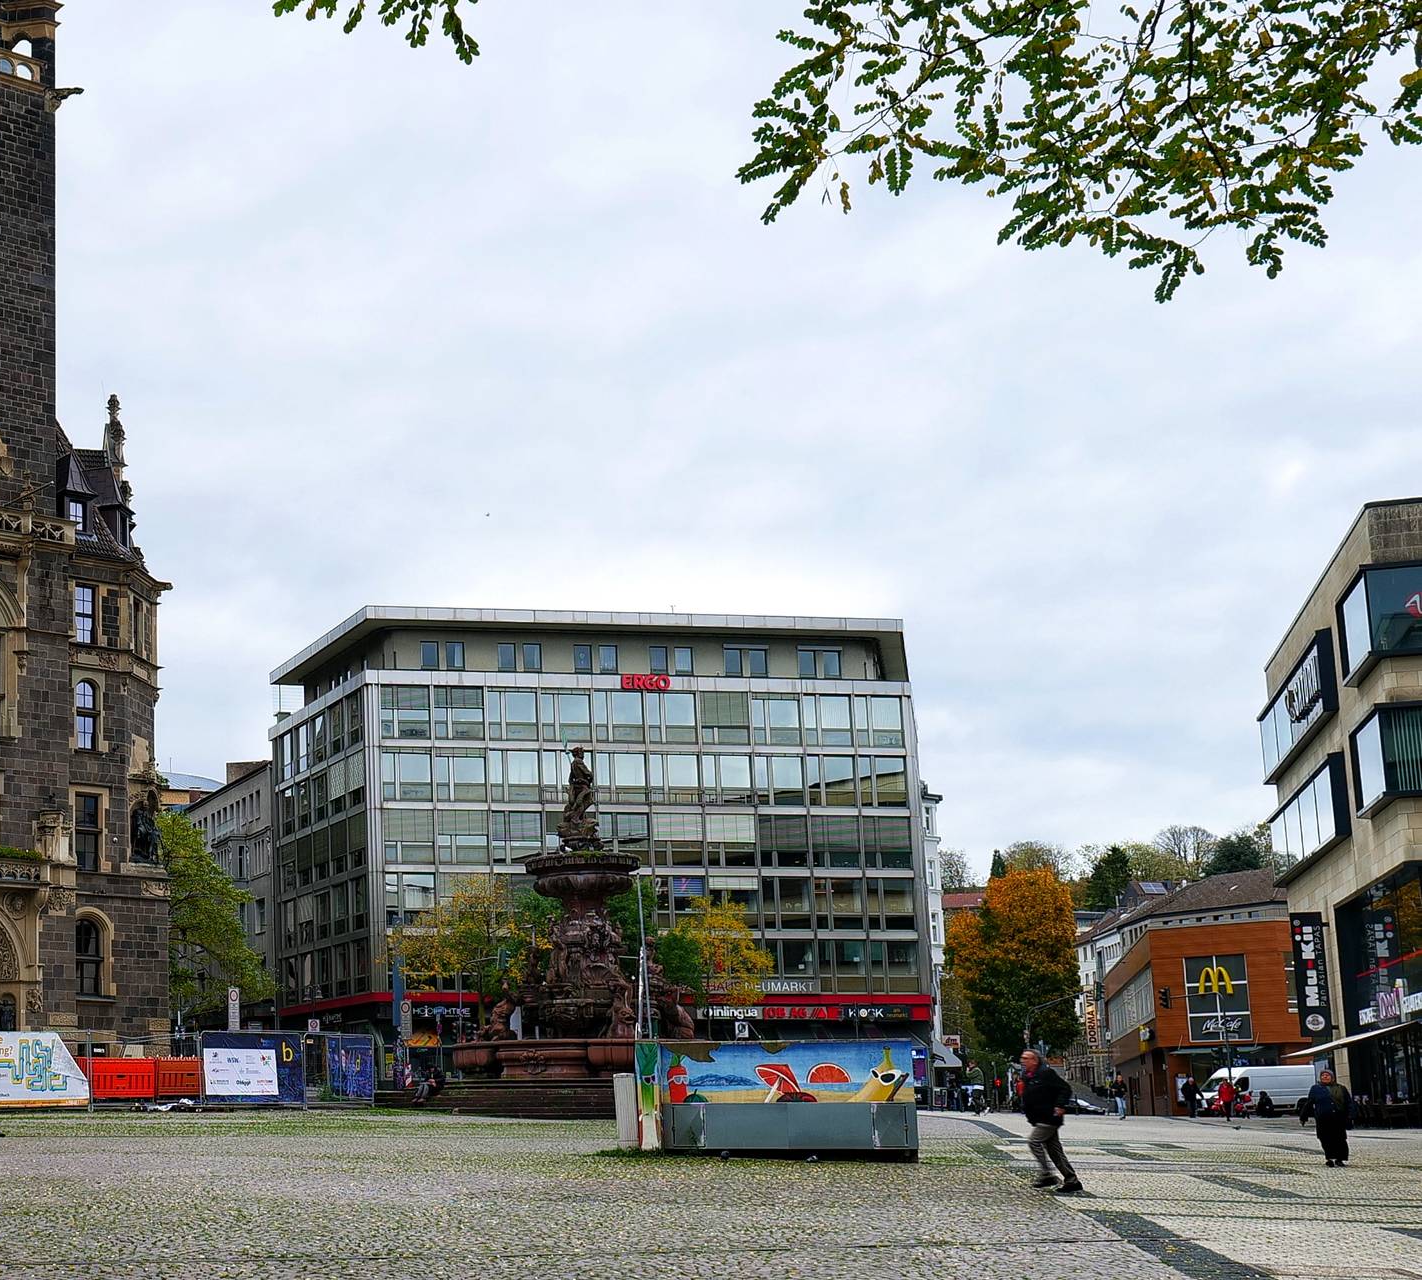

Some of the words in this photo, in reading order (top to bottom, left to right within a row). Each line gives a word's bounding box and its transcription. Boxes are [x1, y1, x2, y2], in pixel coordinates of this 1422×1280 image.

[621, 674, 671, 691] ERGO
[1313, 924, 1323, 956] TAPAS
[1316, 958, 1326, 986] Asian
[744, 981, 814, 992] NEUMARKT
[1318, 988, 1327, 1007] Pan
[713, 1006, 758, 1019] inlingua
[1088, 1011, 1097, 1043] DORMA
[282, 1041, 293, 1062] b
